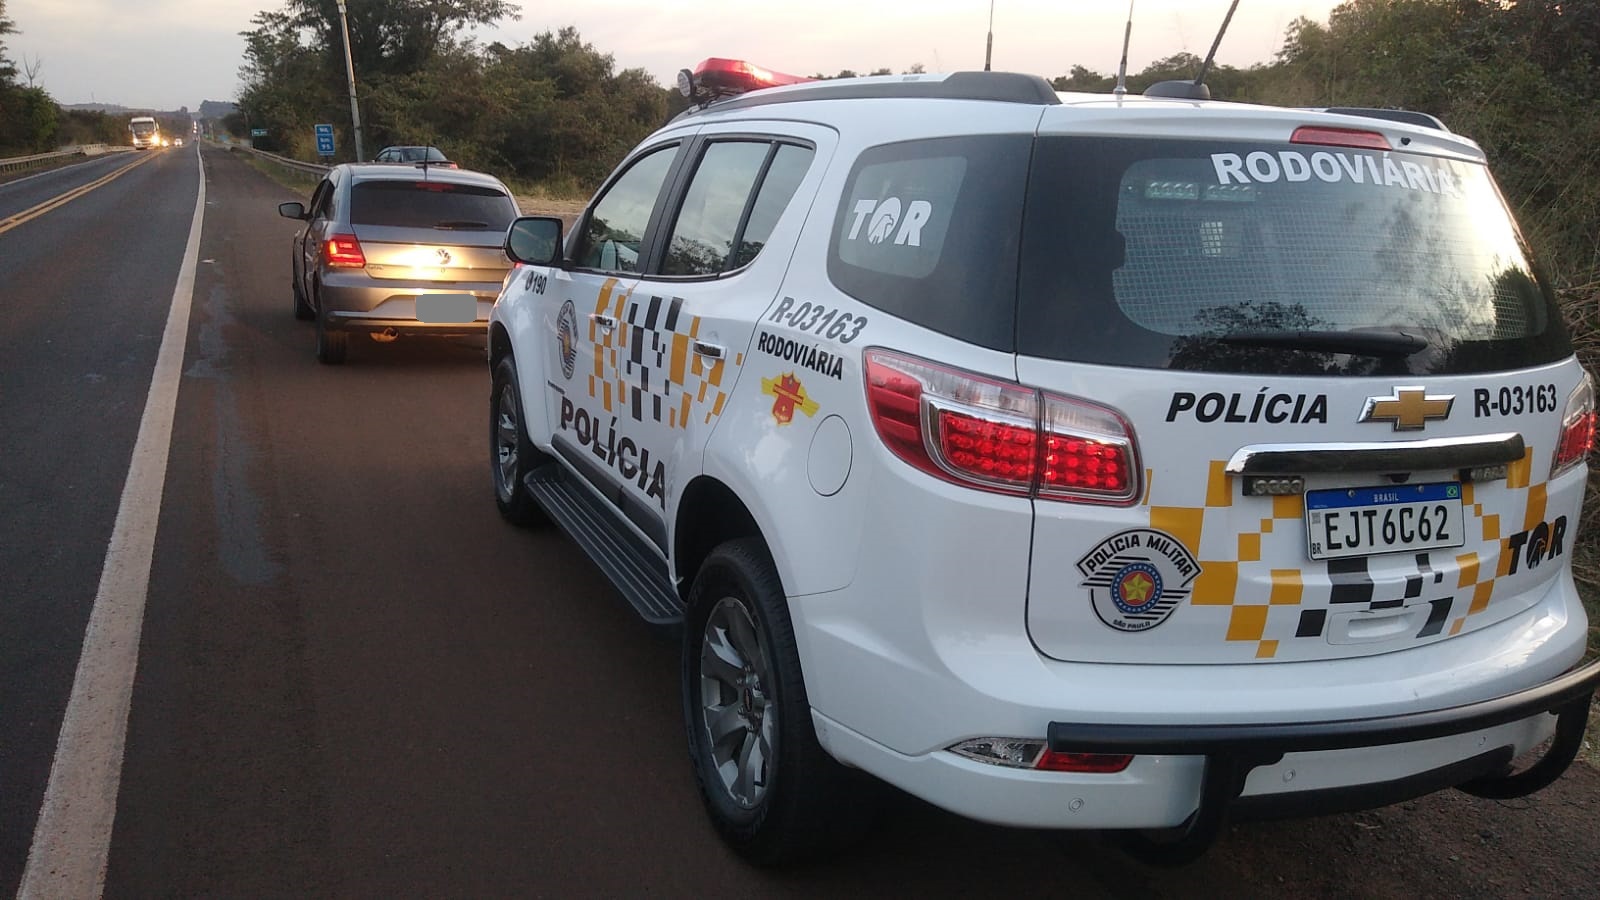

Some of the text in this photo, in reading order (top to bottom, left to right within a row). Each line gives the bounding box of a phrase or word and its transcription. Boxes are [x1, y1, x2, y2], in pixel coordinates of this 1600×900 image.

[1211, 151, 1459, 196] RODOVIÁRIA
[848, 197, 932, 247] TOR
[769, 296, 868, 344] R-03163
[758, 331, 843, 380] RODOVIÁRIA
[1165, 386, 1328, 424] POLÍCIA
[1474, 384, 1557, 418] R-03163
[560, 396, 665, 512] POLÍCIA
[1373, 493, 1399, 503] BRASIL
[1312, 542, 1322, 555] BR
[1324, 505, 1449, 550] EJT6C62
[1508, 515, 1567, 576] TOR
[1085, 534, 1193, 577] POLÍCIA MILITAR
